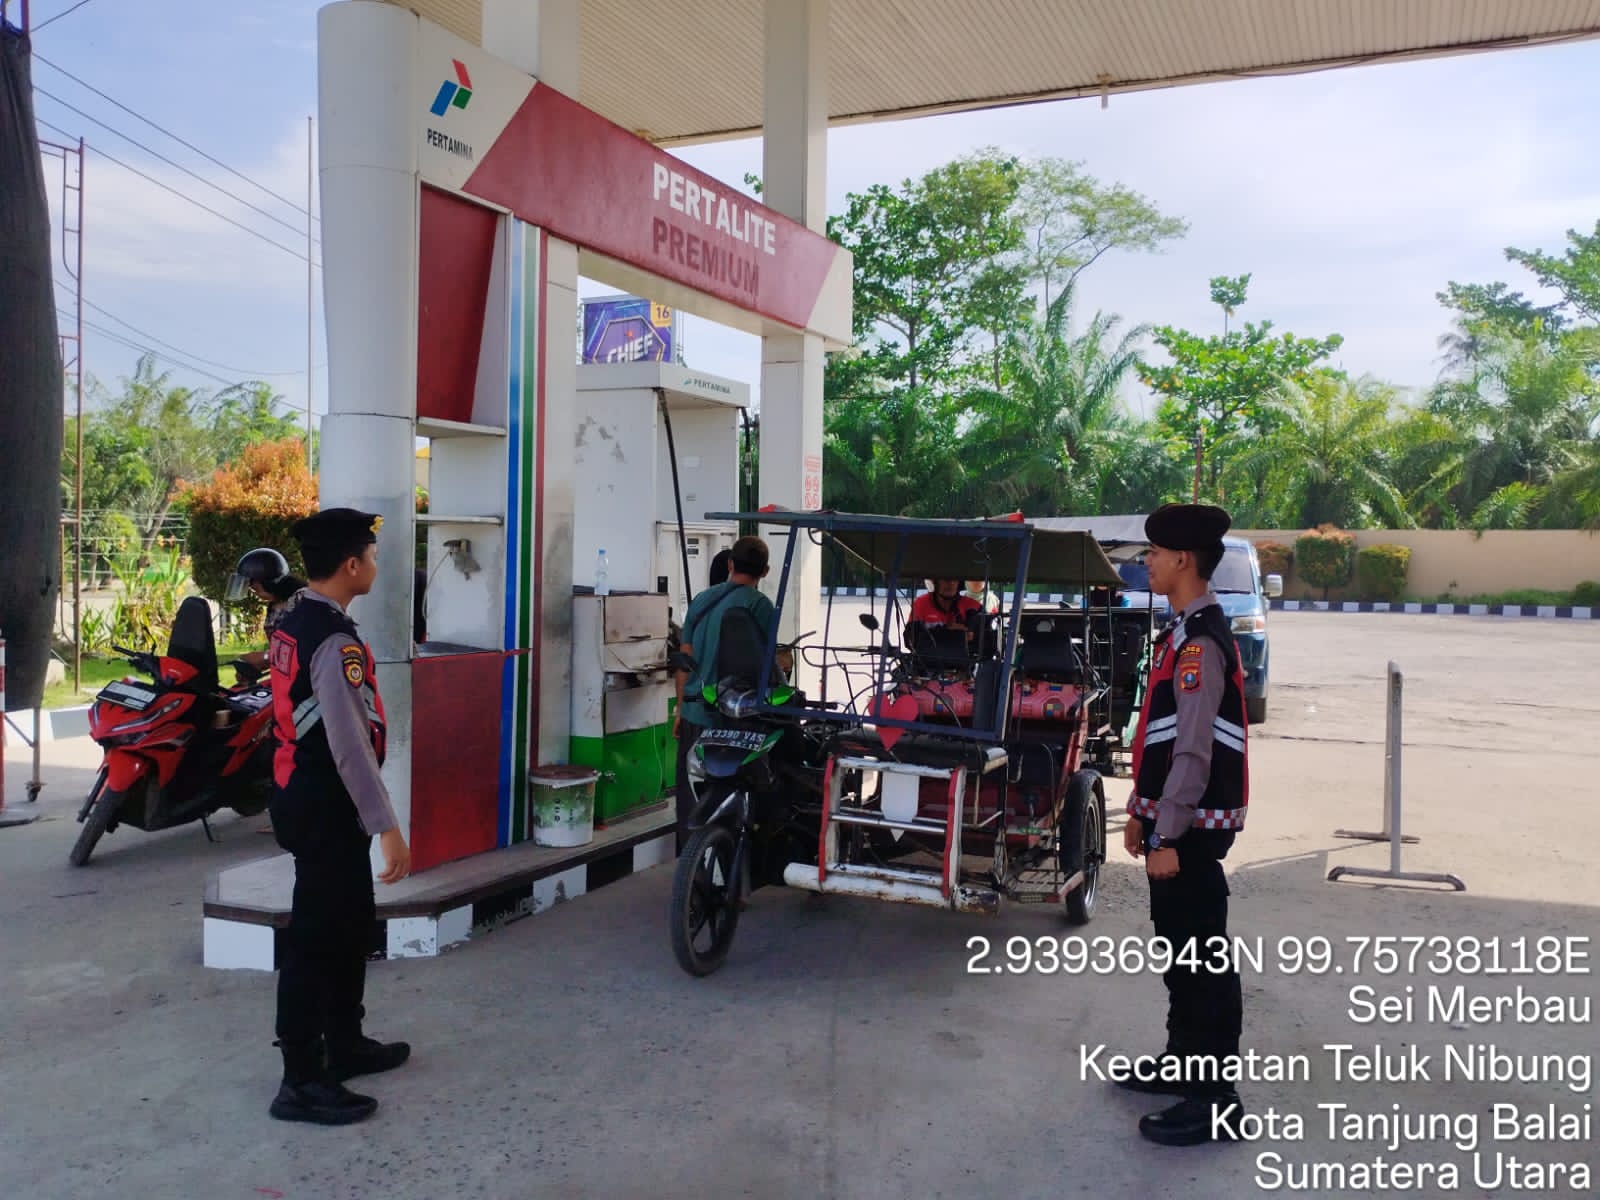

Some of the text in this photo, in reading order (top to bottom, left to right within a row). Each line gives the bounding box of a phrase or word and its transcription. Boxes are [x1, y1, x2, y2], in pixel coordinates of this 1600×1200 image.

[426, 127, 473, 160] PERTAMINA
[653, 161, 776, 256] PERTALITE
[652, 215, 760, 296] PREMIUM
[656, 306, 670, 319] 16
[606, 333, 654, 363] CHIEF
[693, 378, 731, 394] PERTAMINA
